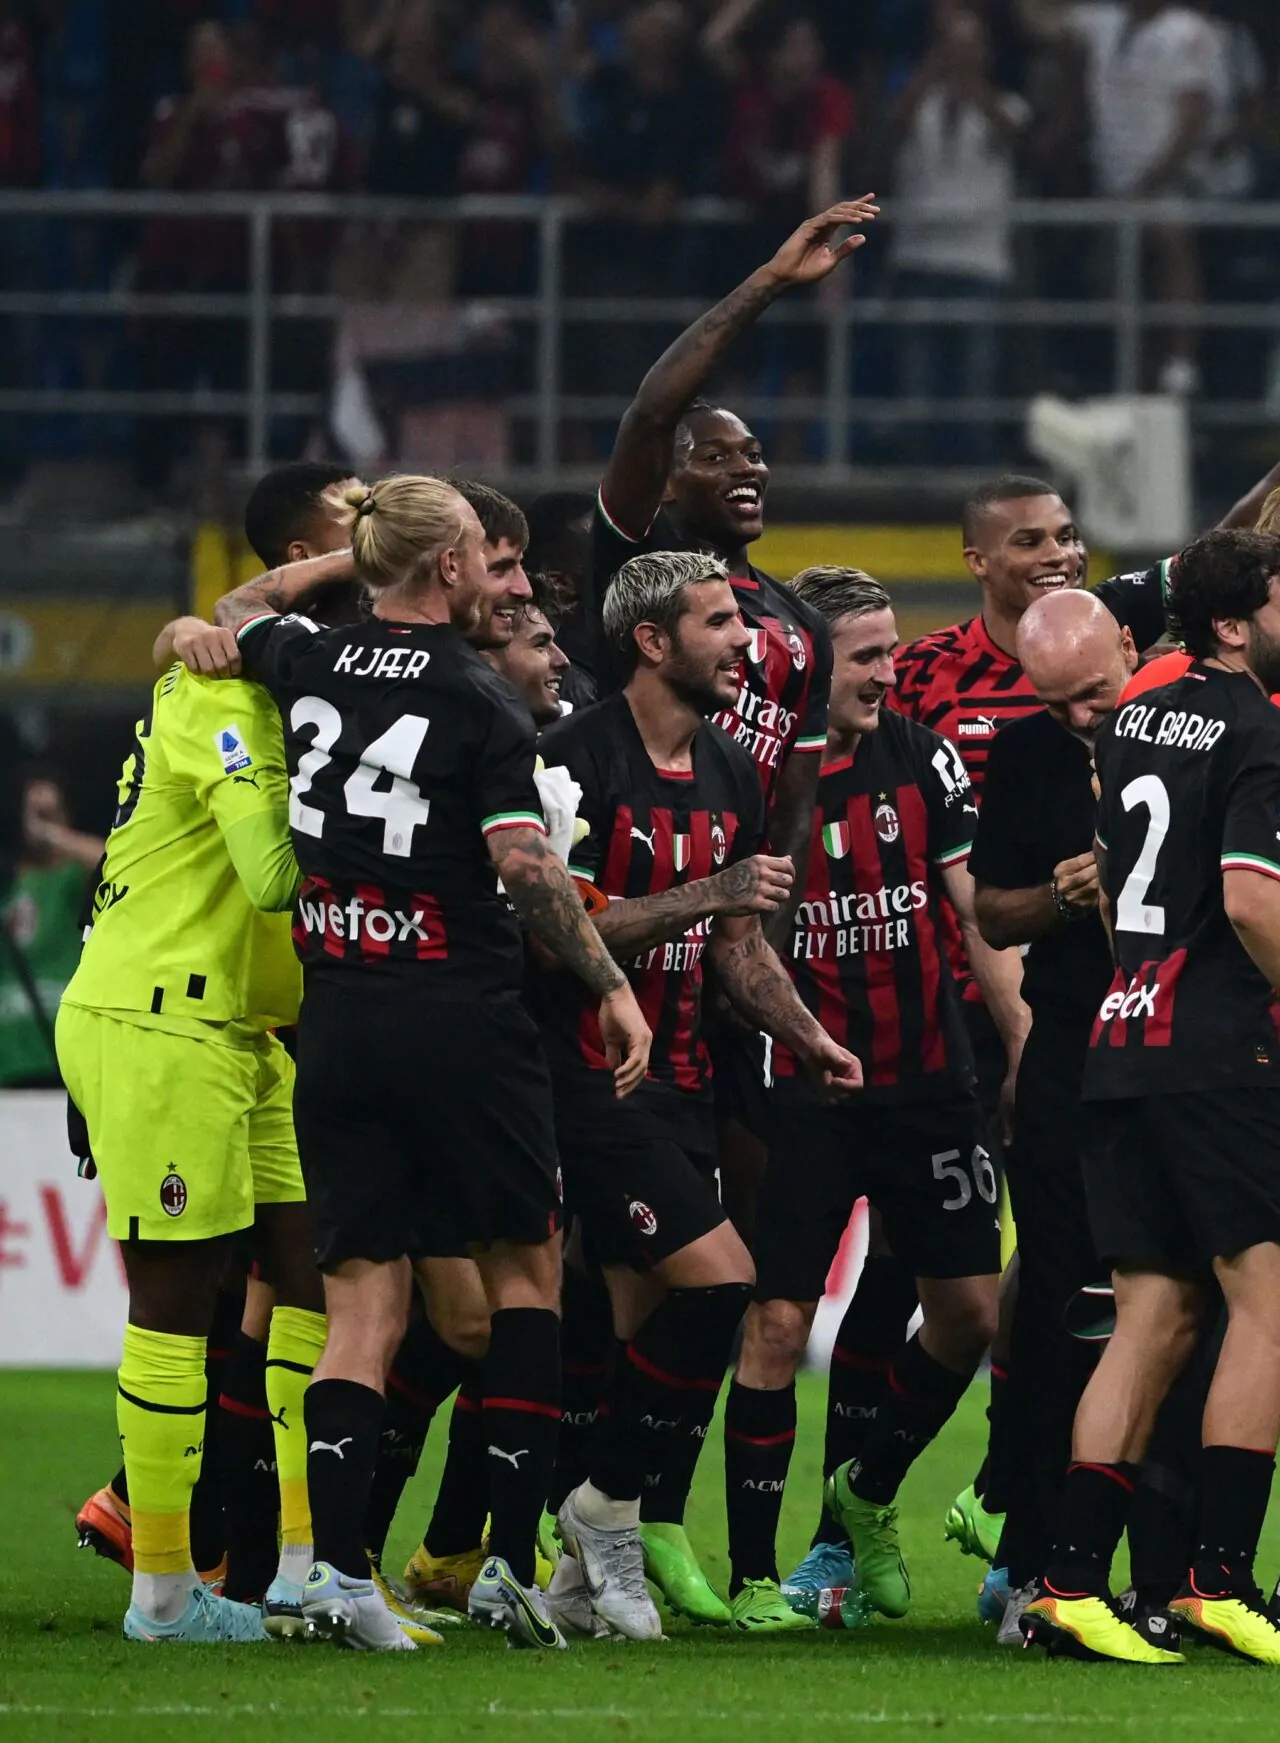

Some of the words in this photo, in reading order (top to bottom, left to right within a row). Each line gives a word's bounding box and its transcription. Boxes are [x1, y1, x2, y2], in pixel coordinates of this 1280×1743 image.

[333, 644, 431, 679] KJÆR
[959, 724, 990, 735] PUMA
[1114, 704, 1226, 752] CALABRIA
[235, 759, 250, 769] TIM
[289, 695, 431, 858] 24
[1116, 775, 1170, 935] 2
[299, 897, 429, 942] wefox
[794, 881, 928, 926] mirates
[793, 931, 828, 959] FLY
[836, 918, 910, 957] BETTER
[931, 1144, 997, 1211] 56
[834, 1402, 878, 1419] ACM
[742, 1479, 785, 1492] ACM
